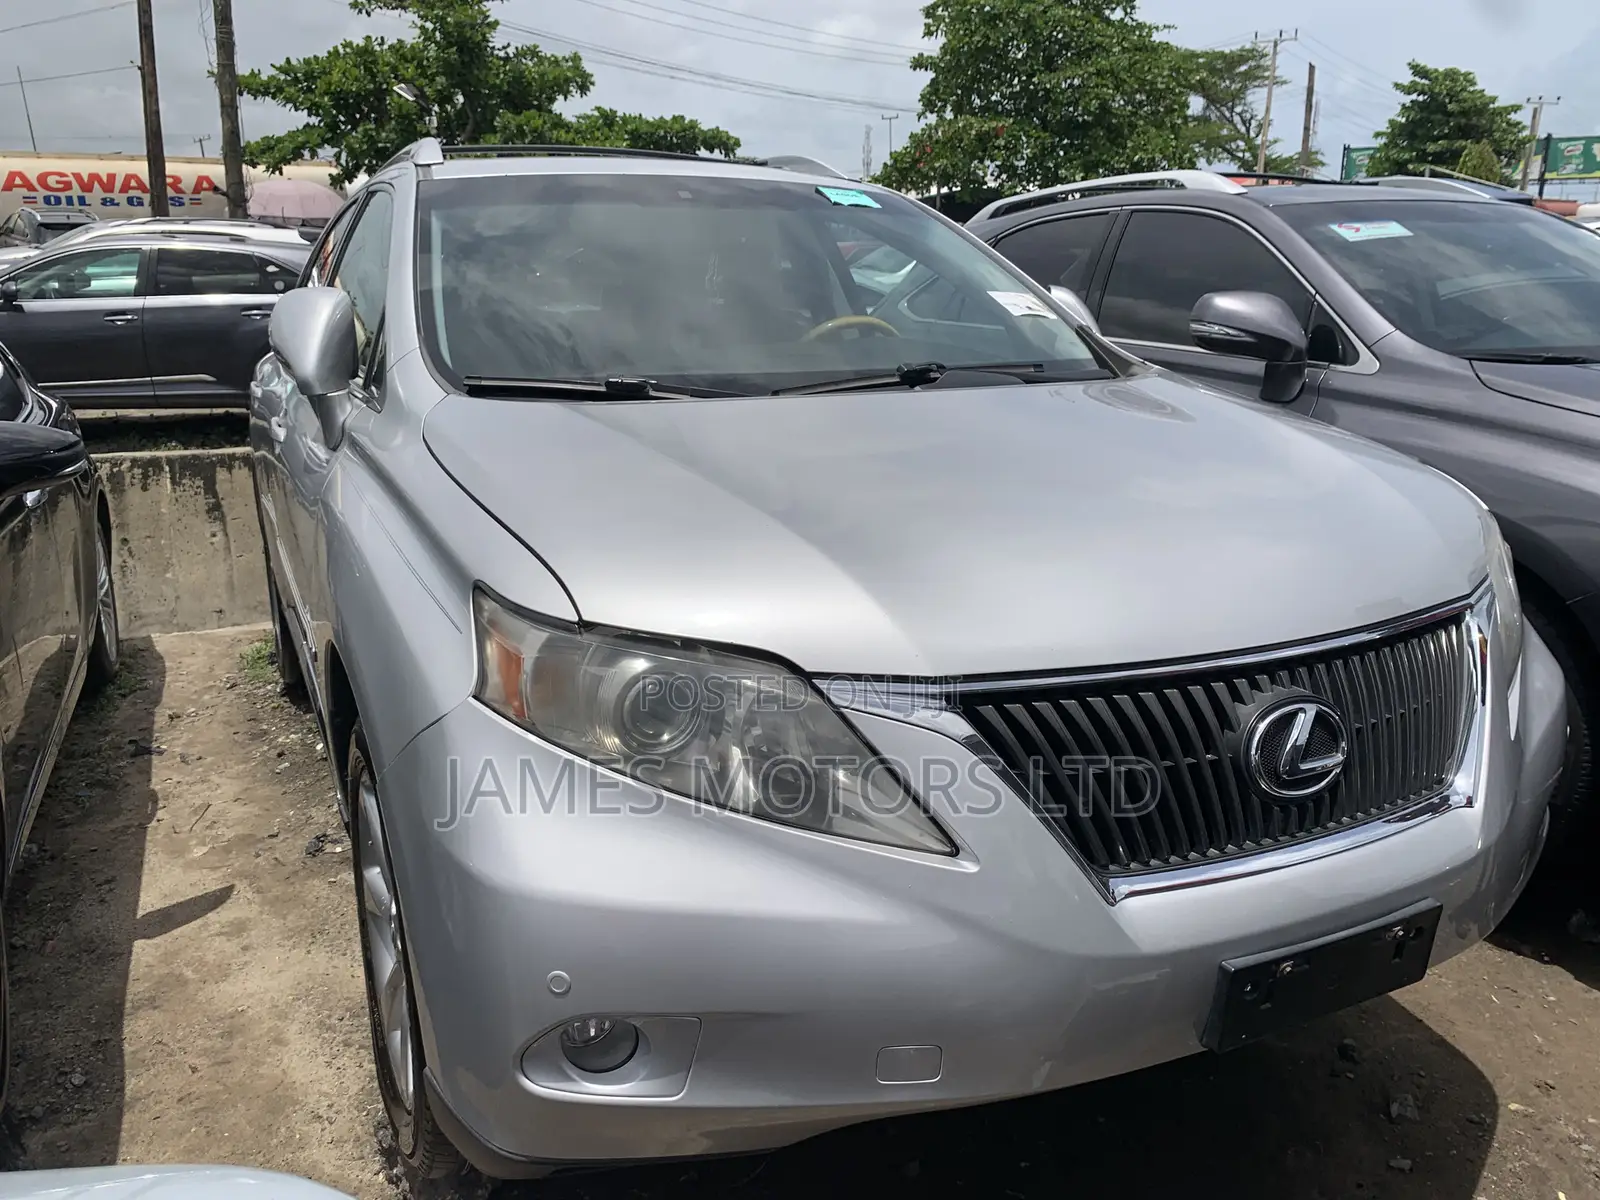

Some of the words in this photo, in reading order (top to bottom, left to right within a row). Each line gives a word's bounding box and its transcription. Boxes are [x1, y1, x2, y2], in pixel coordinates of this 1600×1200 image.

[1, 171, 216, 194] AGWARA
[43, 194, 91, 206] OIL
[100, 196, 120, 207] &
[126, 195, 186, 207] GS
